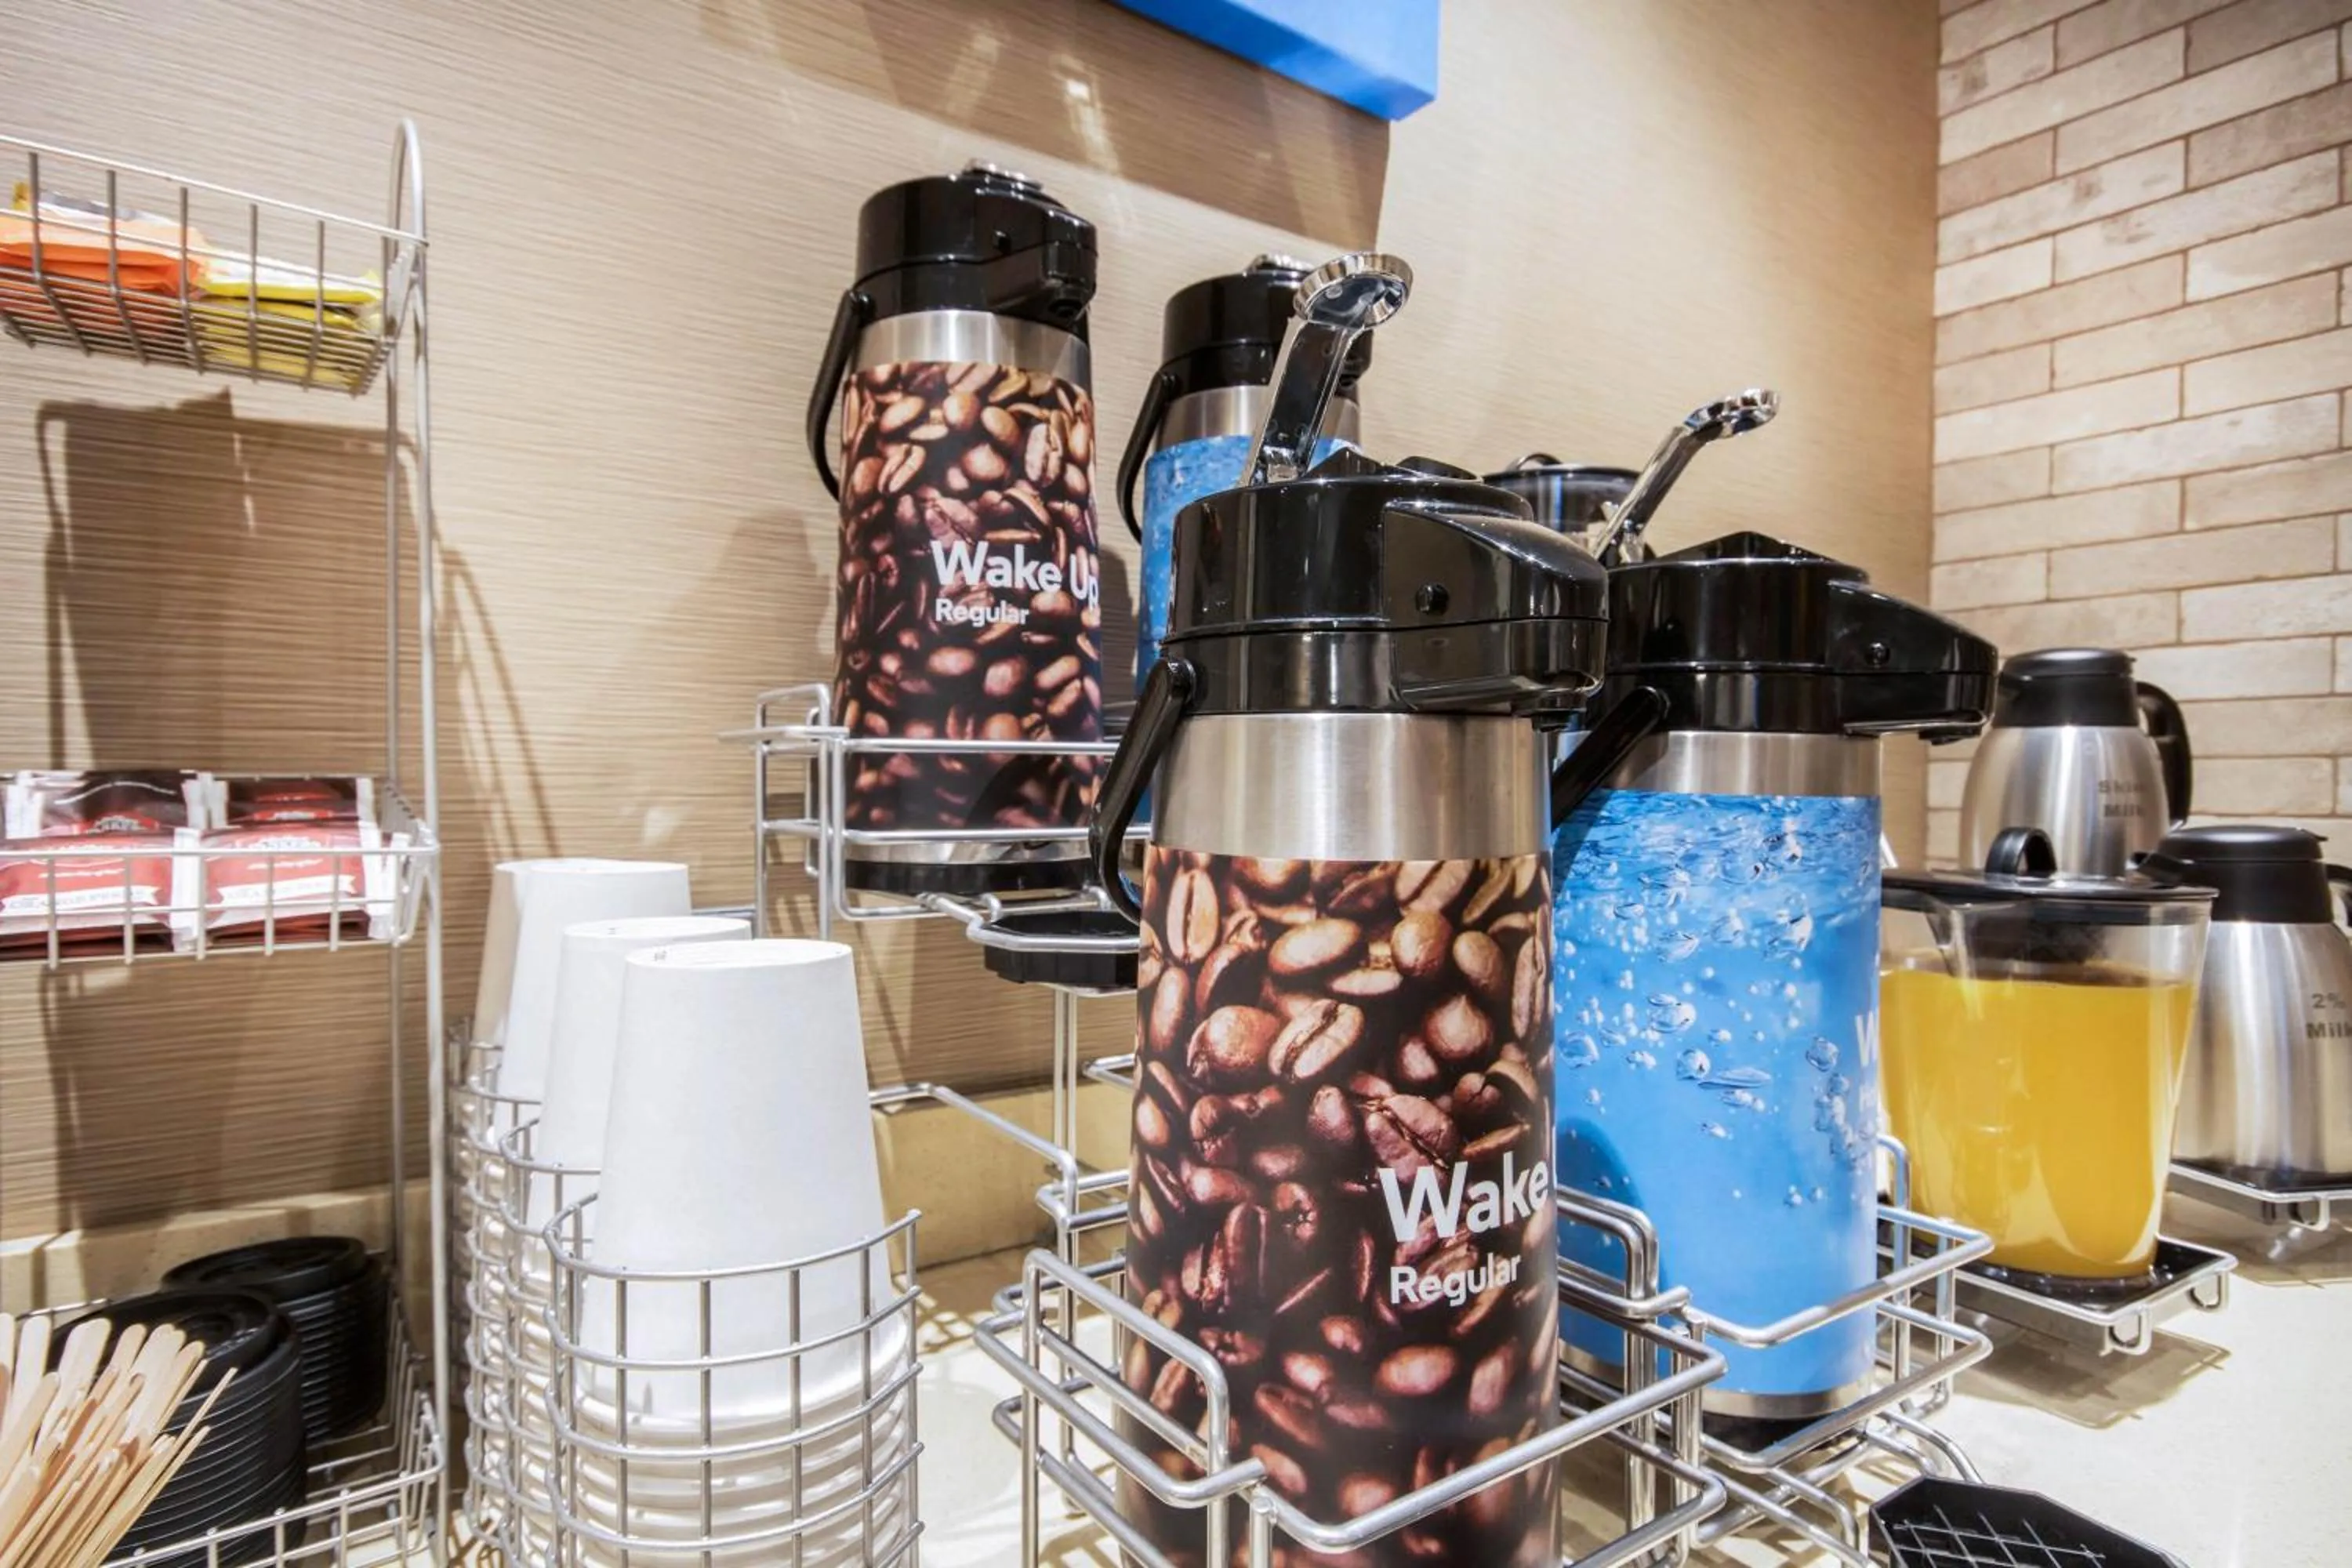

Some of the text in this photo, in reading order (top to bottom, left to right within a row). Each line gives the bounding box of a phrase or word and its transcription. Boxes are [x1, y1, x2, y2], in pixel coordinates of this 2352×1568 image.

[930, 539, 1062, 593] Wake
[935, 597, 1029, 627] Regular
[2311, 993, 2347, 1009] 2%
[1378, 1151, 1548, 1242] Wake
[1390, 1253, 1522, 1307] Regular
